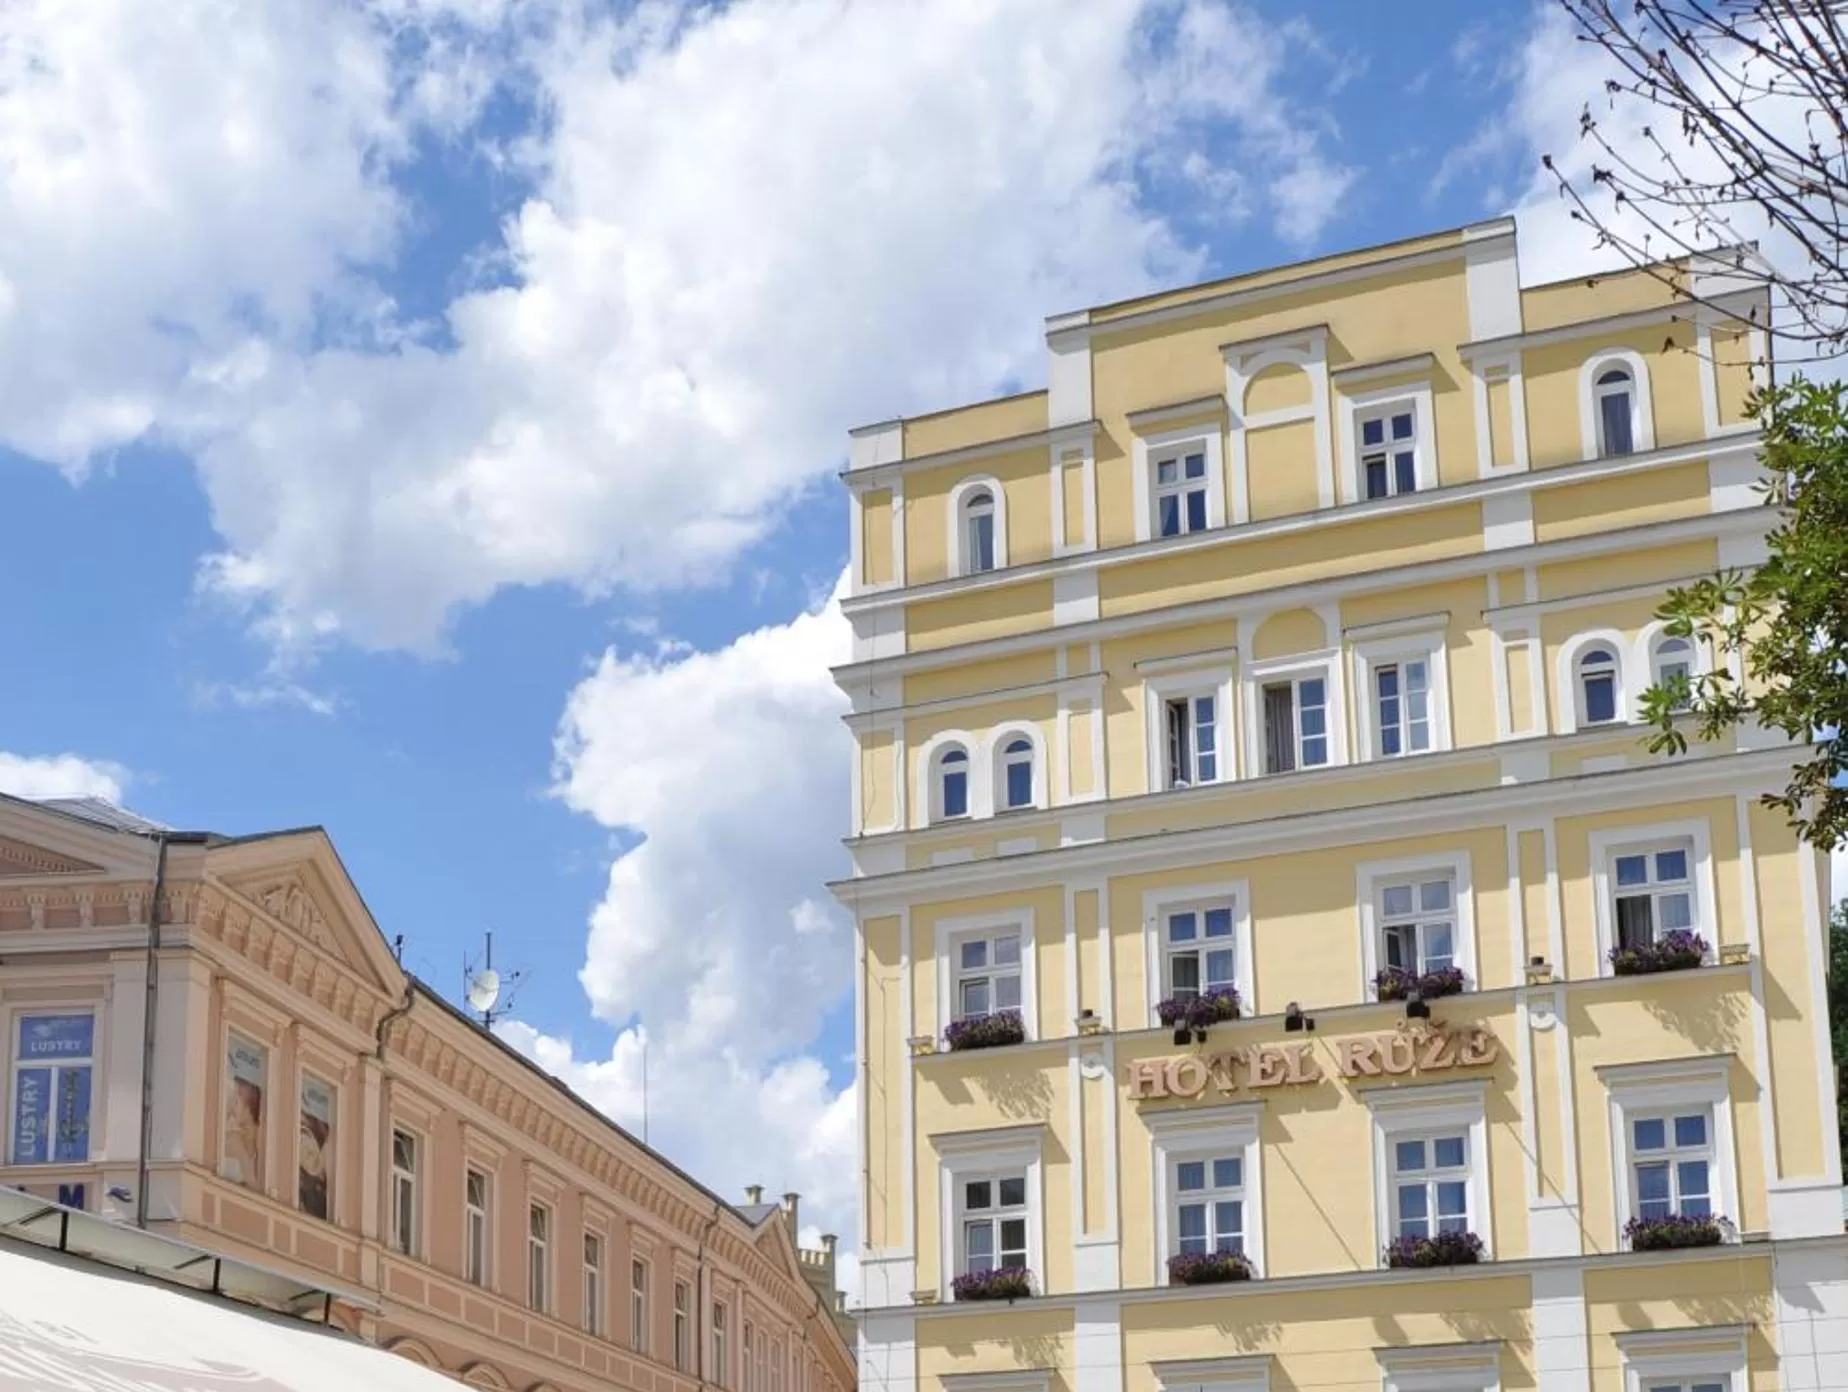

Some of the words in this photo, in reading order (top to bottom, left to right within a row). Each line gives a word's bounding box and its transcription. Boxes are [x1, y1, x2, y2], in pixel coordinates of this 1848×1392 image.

[1126, 1038, 1323, 1100] HOTEL
[1336, 1019, 1499, 1077] RŮŽE
[20, 1076, 39, 1156] LUSTRY
